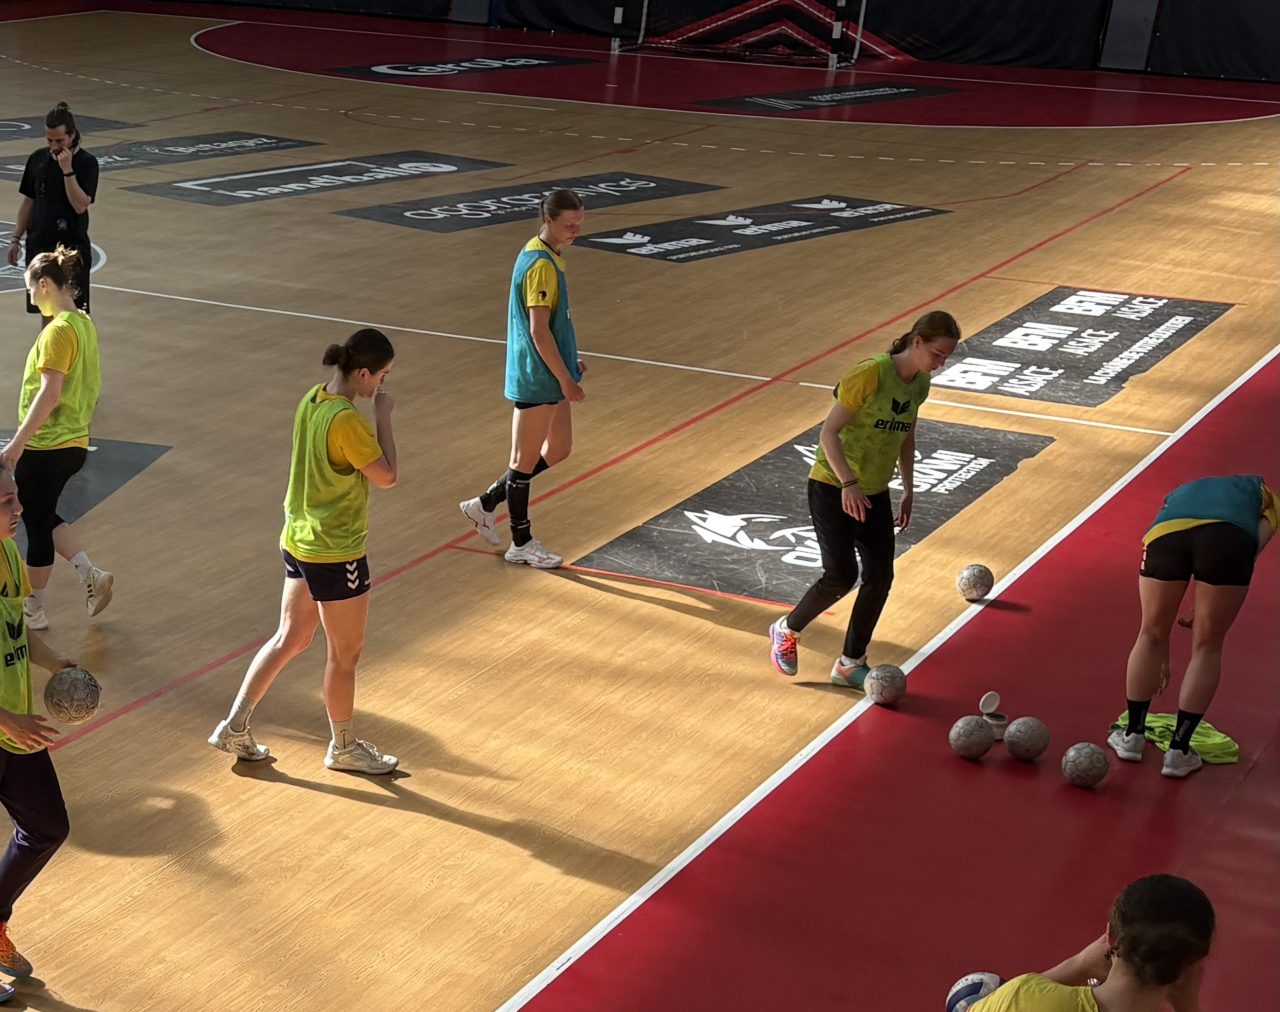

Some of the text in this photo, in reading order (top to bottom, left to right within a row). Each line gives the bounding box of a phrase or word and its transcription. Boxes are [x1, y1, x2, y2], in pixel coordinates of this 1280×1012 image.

[371, 58, 550, 76] Carola
[212, 164, 414, 198] handball
[732, 220, 814, 235] erima
[626, 238, 715, 255] erima
[1049, 290, 1130, 317] BFM
[1112, 296, 1169, 321] ALSACE
[992, 322, 1079, 352] BFM
[1058, 328, 1120, 356] ALSACE
[930, 357, 1022, 391] BFM
[997, 365, 1065, 396] ALSACE
[874, 417, 912, 432] erima
[931, 457, 996, 495] PROTECTION
